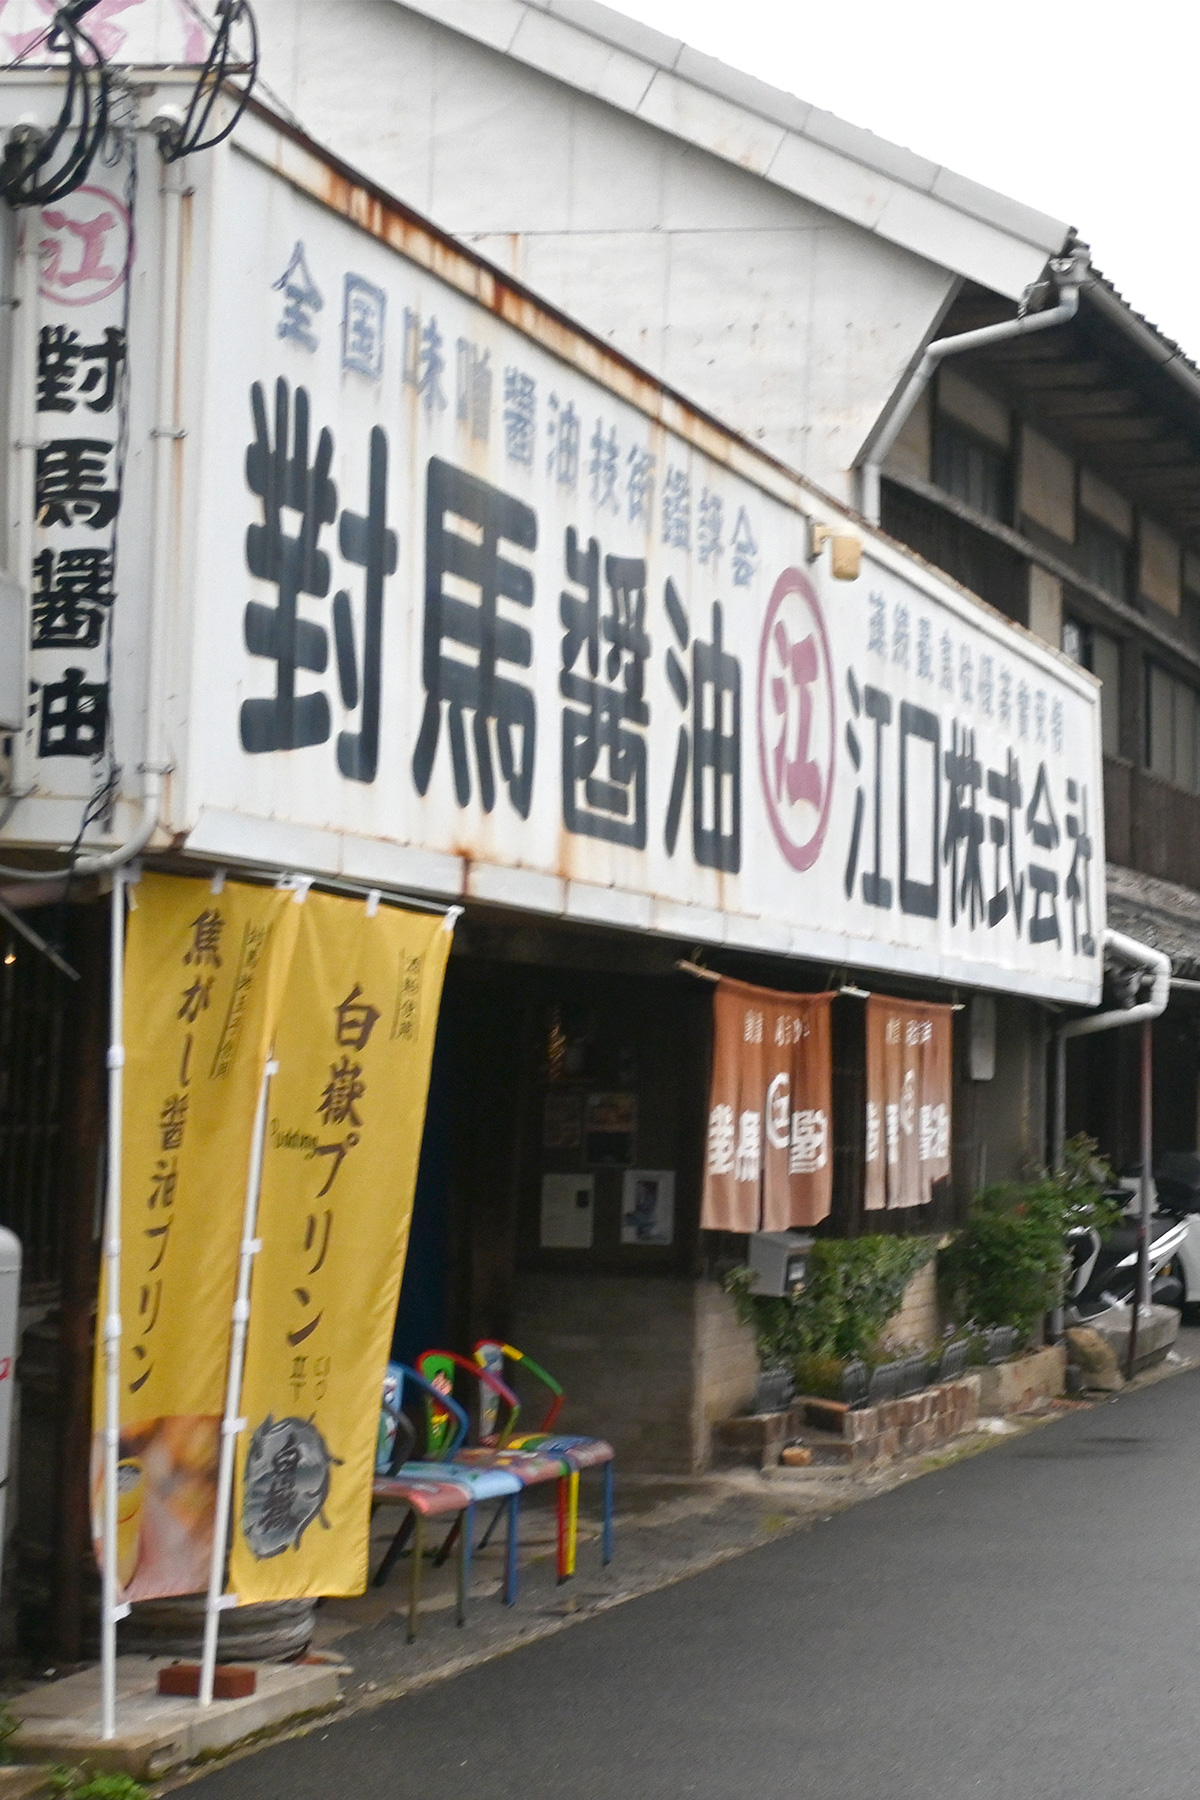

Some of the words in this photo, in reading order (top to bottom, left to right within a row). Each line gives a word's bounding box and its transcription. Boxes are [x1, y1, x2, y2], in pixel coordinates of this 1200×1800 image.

[843, 664, 1096, 958] 江口株式会社
[286, 983, 381, 1347] 白嶽プリン
